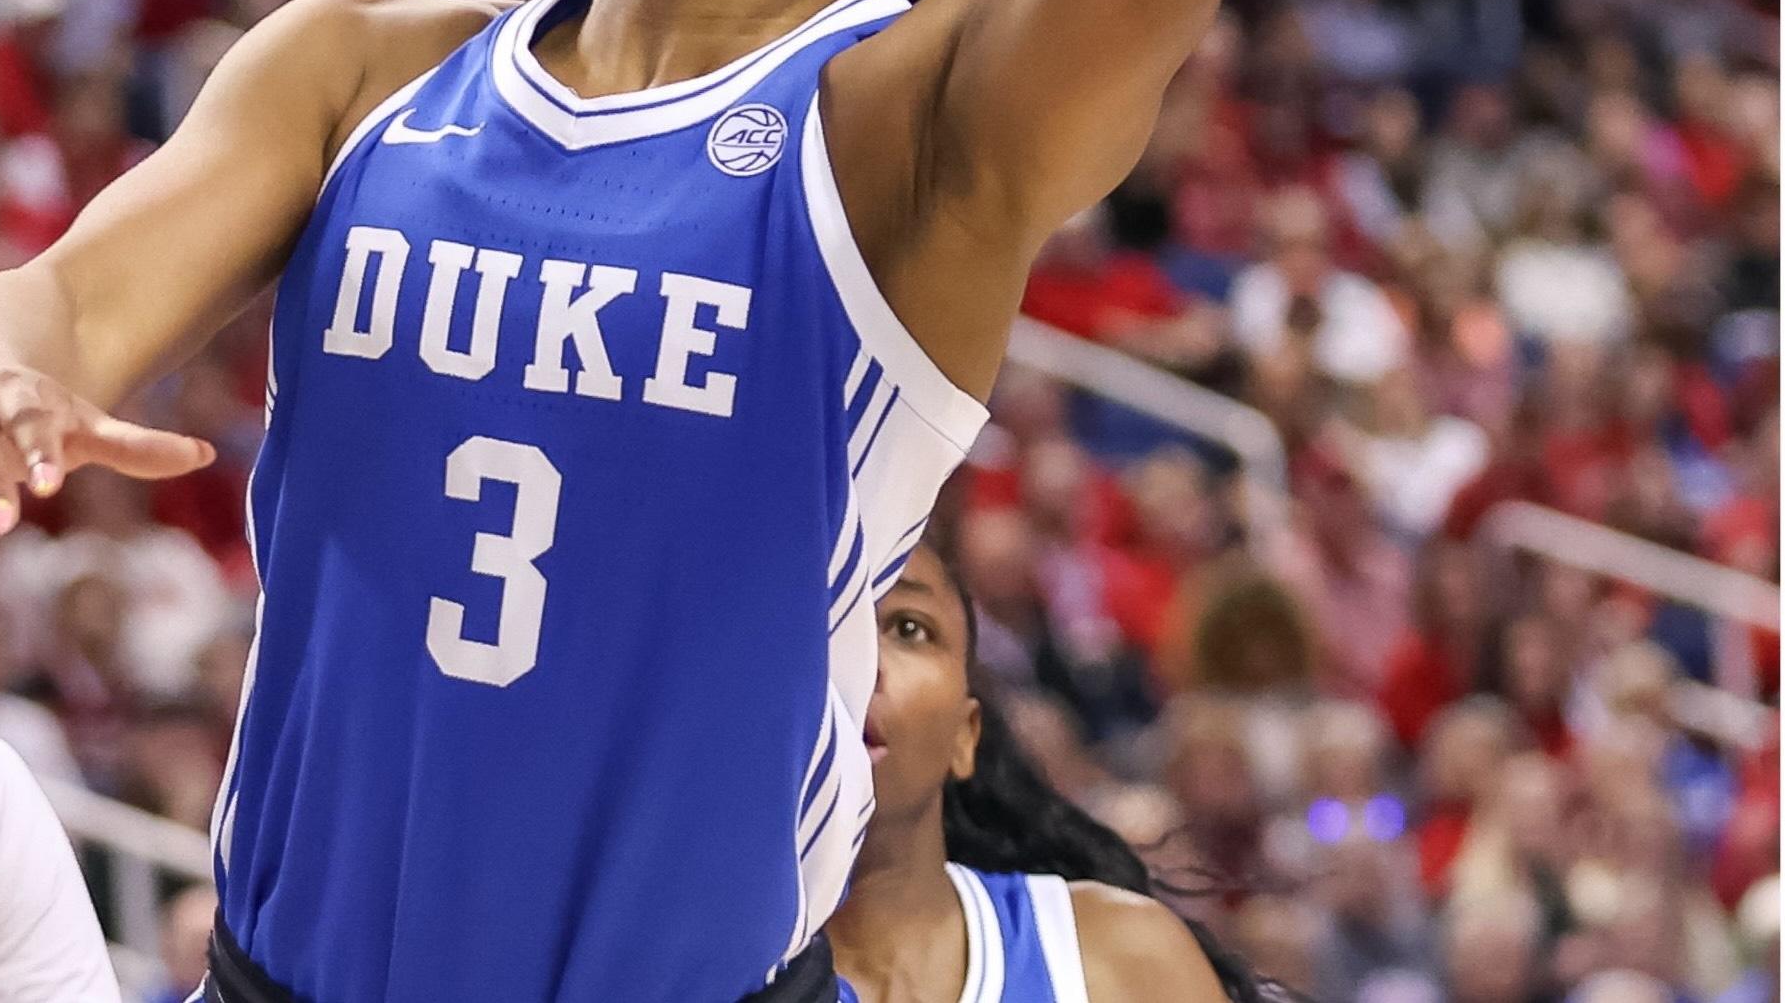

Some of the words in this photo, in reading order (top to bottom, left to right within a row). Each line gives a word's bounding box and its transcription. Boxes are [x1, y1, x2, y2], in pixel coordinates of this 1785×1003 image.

[721, 129, 783, 145] ACC
[323, 225, 754, 419] DUKE
[425, 434, 564, 689] 3
